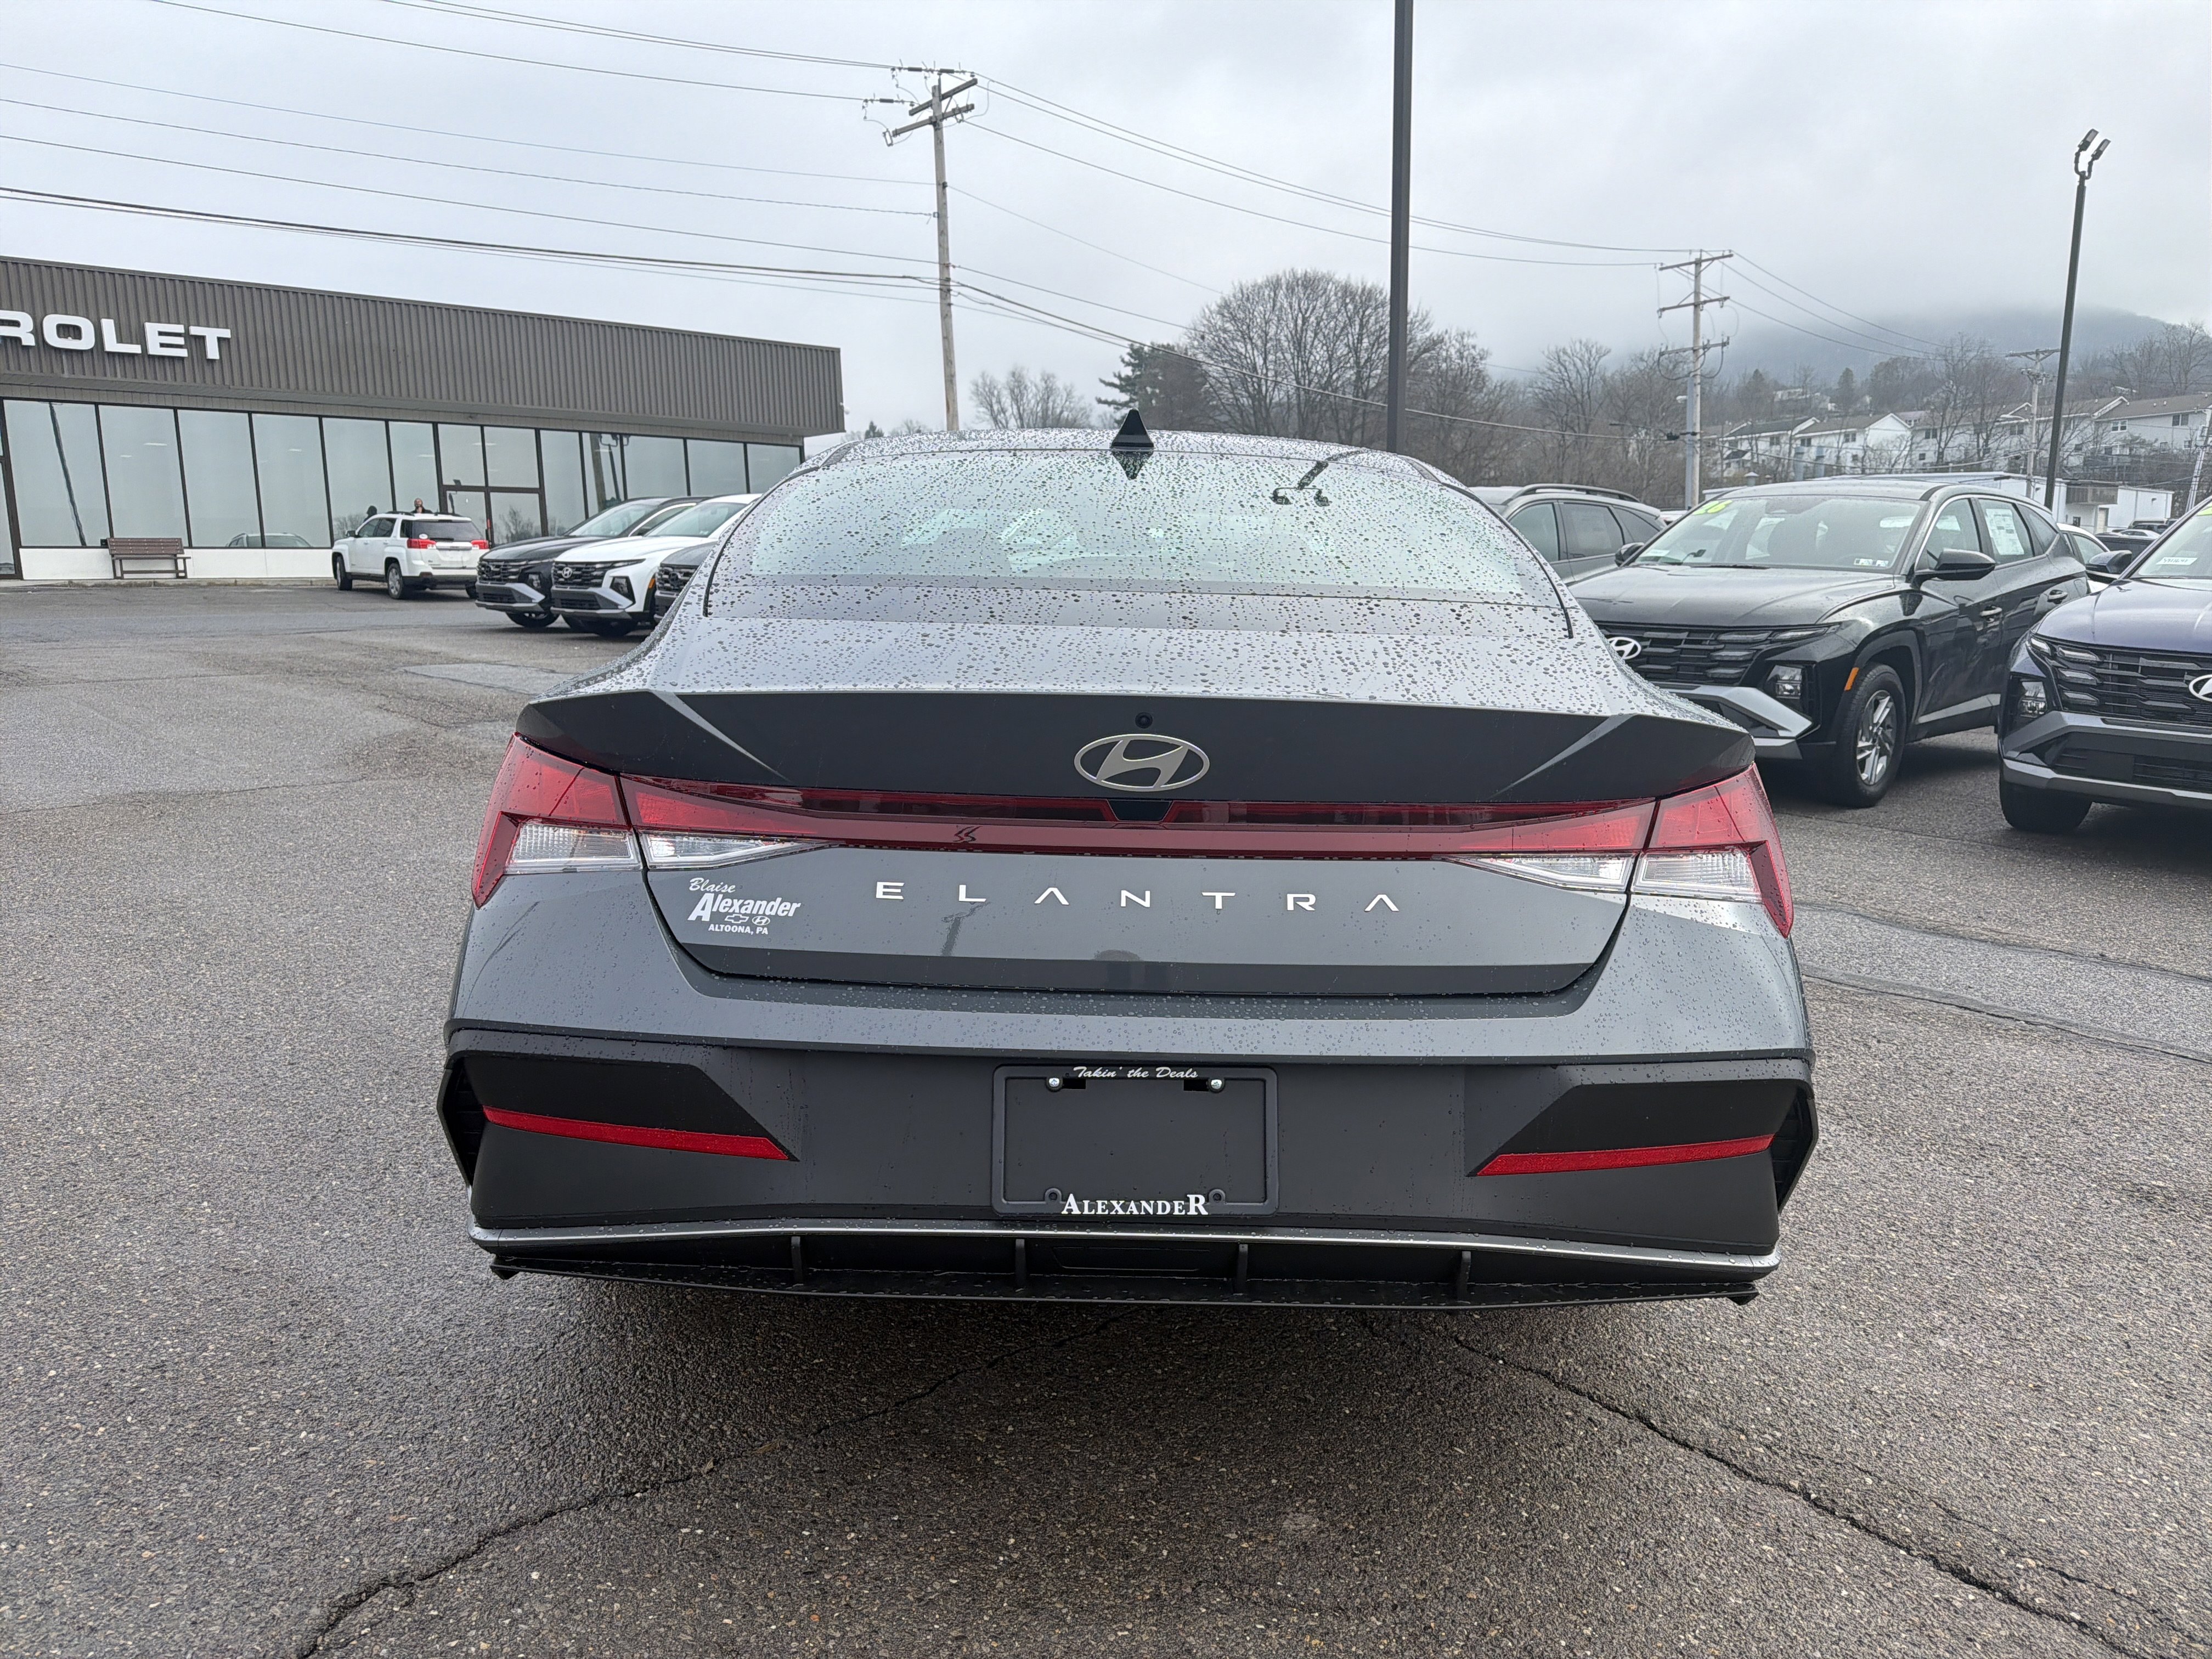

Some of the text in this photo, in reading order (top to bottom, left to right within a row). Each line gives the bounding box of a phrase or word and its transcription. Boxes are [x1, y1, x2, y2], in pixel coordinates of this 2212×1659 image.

[1691, 500, 1733, 515] 26
[689, 877, 736, 893] Blaise
[876, 882, 1399, 912] ELANTRA
[687, 893, 802, 922] Alexander
[708, 924, 769, 935] ALTOONA, PA
[1073, 1066, 1199, 1078] Takin' the Deals
[1061, 1193, 1209, 1215] ALEXANDER
